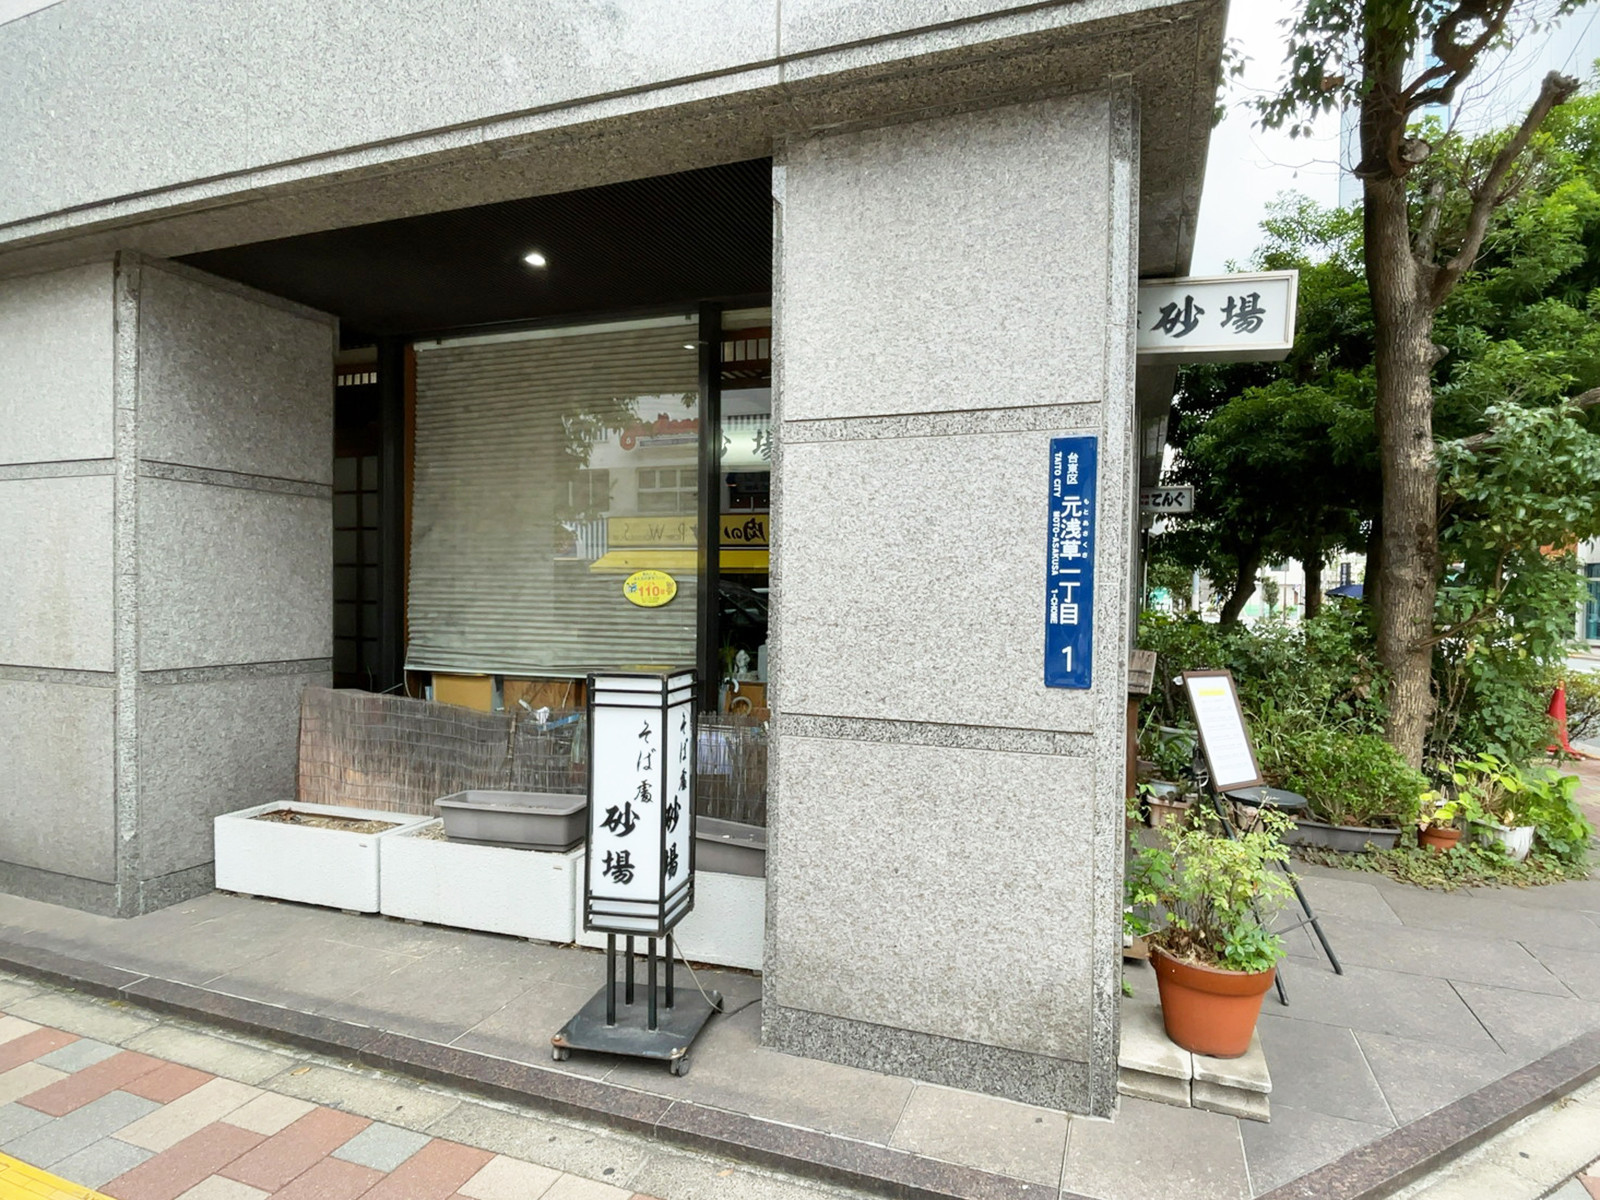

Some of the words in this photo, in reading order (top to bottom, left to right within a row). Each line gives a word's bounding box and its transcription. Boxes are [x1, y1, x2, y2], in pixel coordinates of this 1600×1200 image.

[1150, 292, 1266, 338] 砂場
[1053, 451, 1063, 476] TAITO
[1066, 452, 1079, 485] 台東区
[1052, 478, 1062, 497] CITY
[1151, 491, 1186, 507] てんぐ
[1051, 511, 1061, 576] MOTO-ASAKUSA
[1058, 496, 1082, 625] 元浅草一丁目
[1050, 588, 1059, 625] 1-CHOME
[1061, 645, 1072, 673] 1
[600, 801, 641, 885] 砂場
